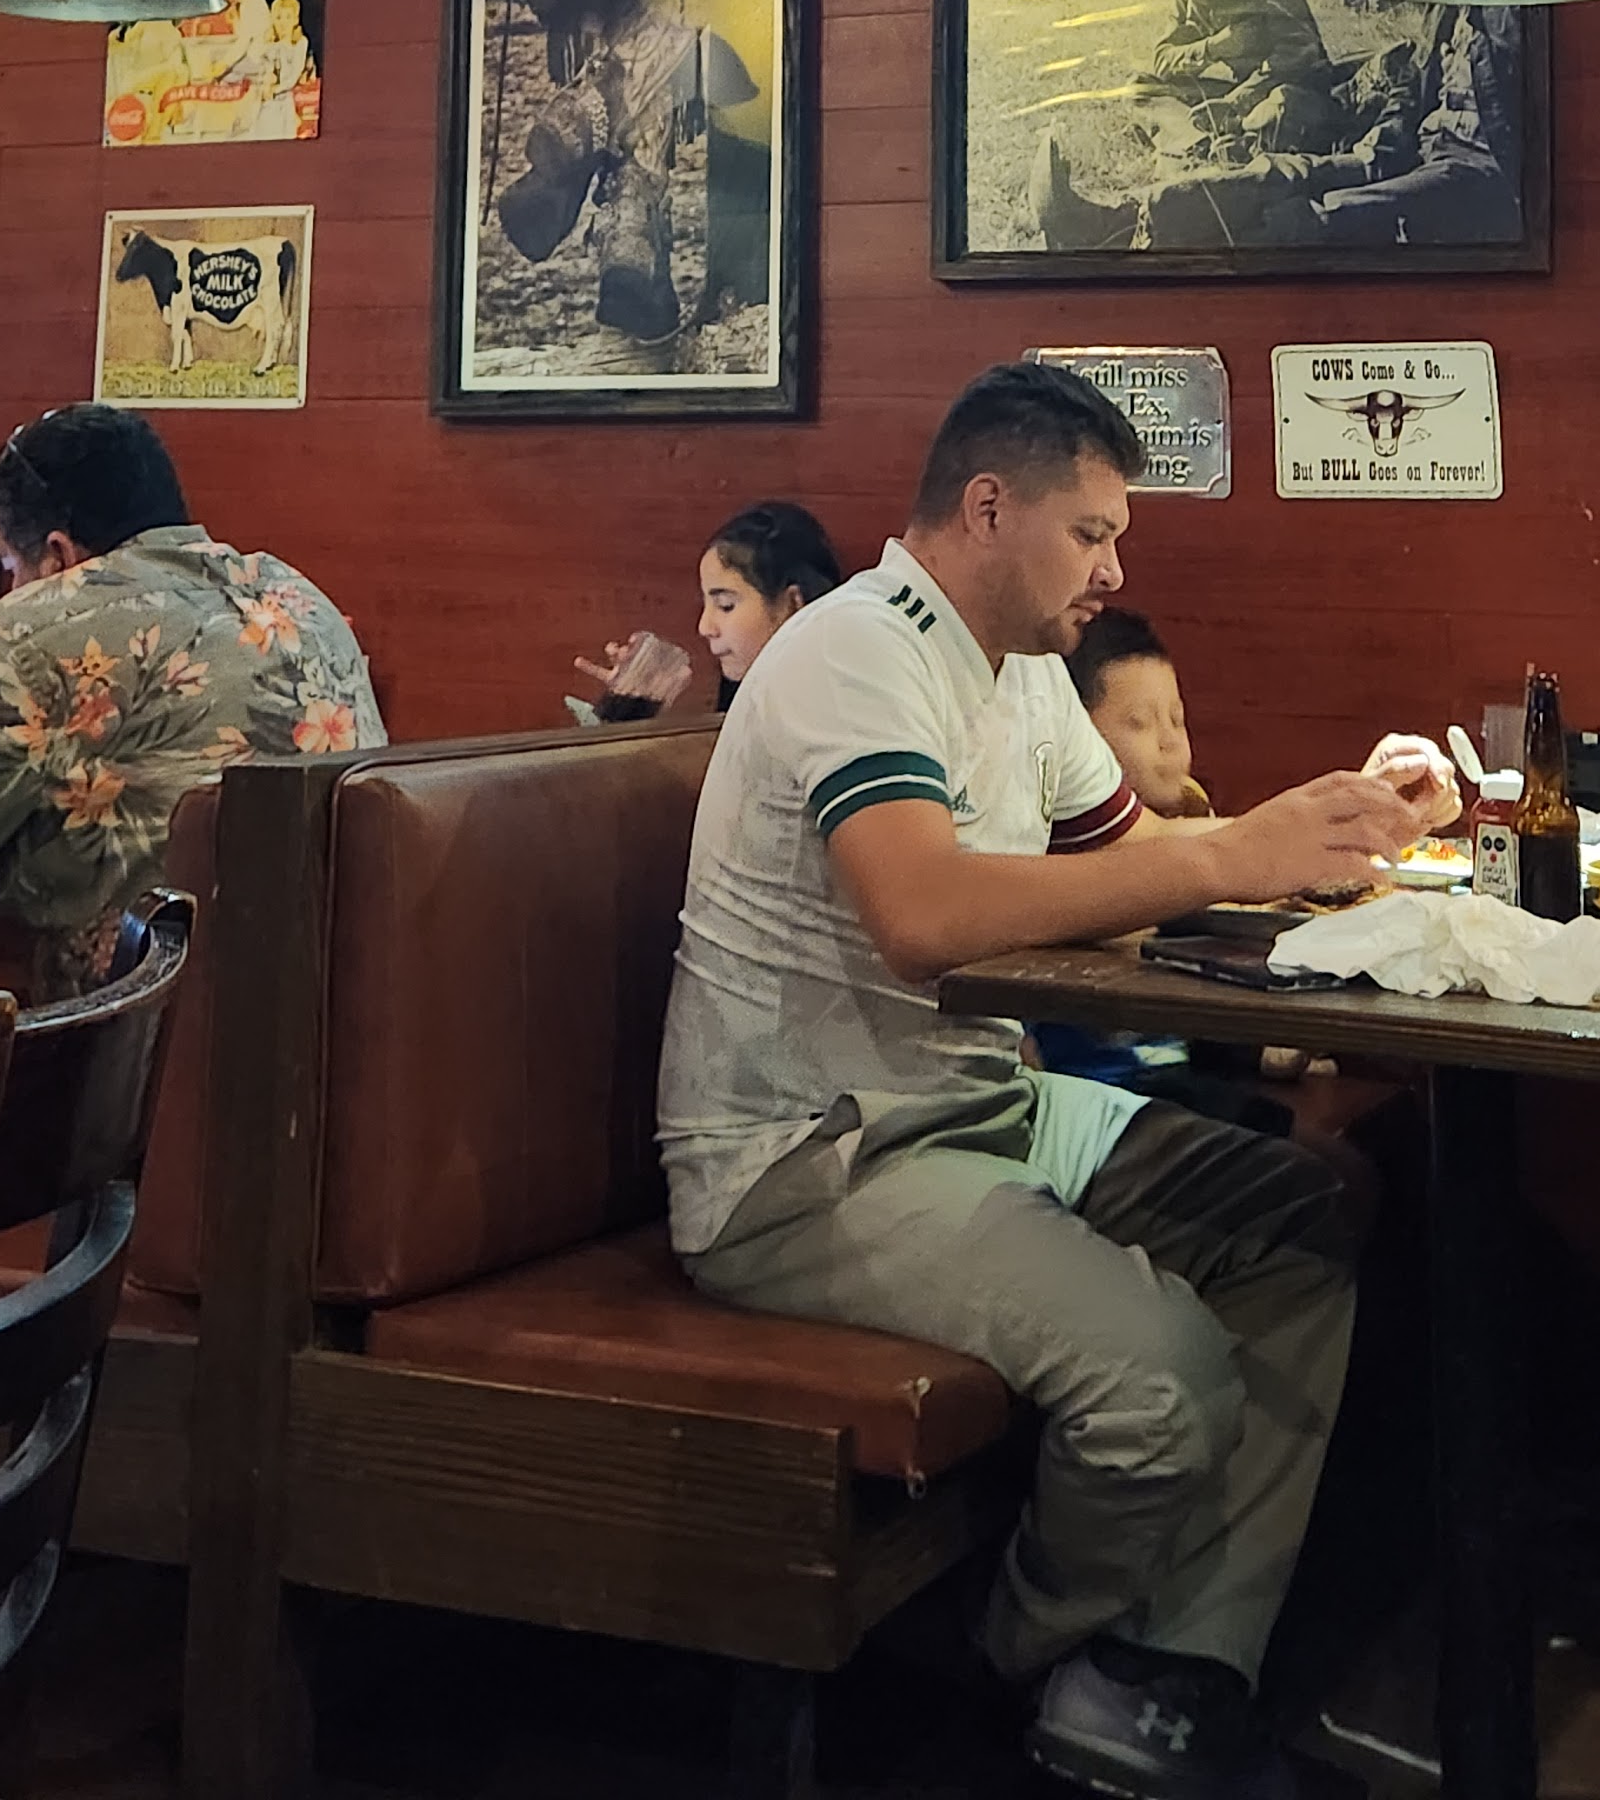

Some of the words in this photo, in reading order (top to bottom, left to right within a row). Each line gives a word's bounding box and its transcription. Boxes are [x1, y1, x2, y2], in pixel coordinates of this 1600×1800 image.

[193, 255, 258, 281] HERSHEY'S
[206, 273, 245, 291] MILK
[192, 283, 257, 310] CHOCOLATE
[1128, 360, 1190, 387] miss
[1312, 359, 1354, 381] COWS
[1362, 361, 1394, 380] Come
[1404, 360, 1416, 380] &
[1424, 360, 1455, 380] Go...
[1188, 417, 1212, 447] is
[1292, 462, 1313, 481] But
[1321, 459, 1361, 481] BULL
[1369, 461, 1398, 481] Goes
[1407, 465, 1421, 481] on
[1431, 461, 1486, 481] Forever!
